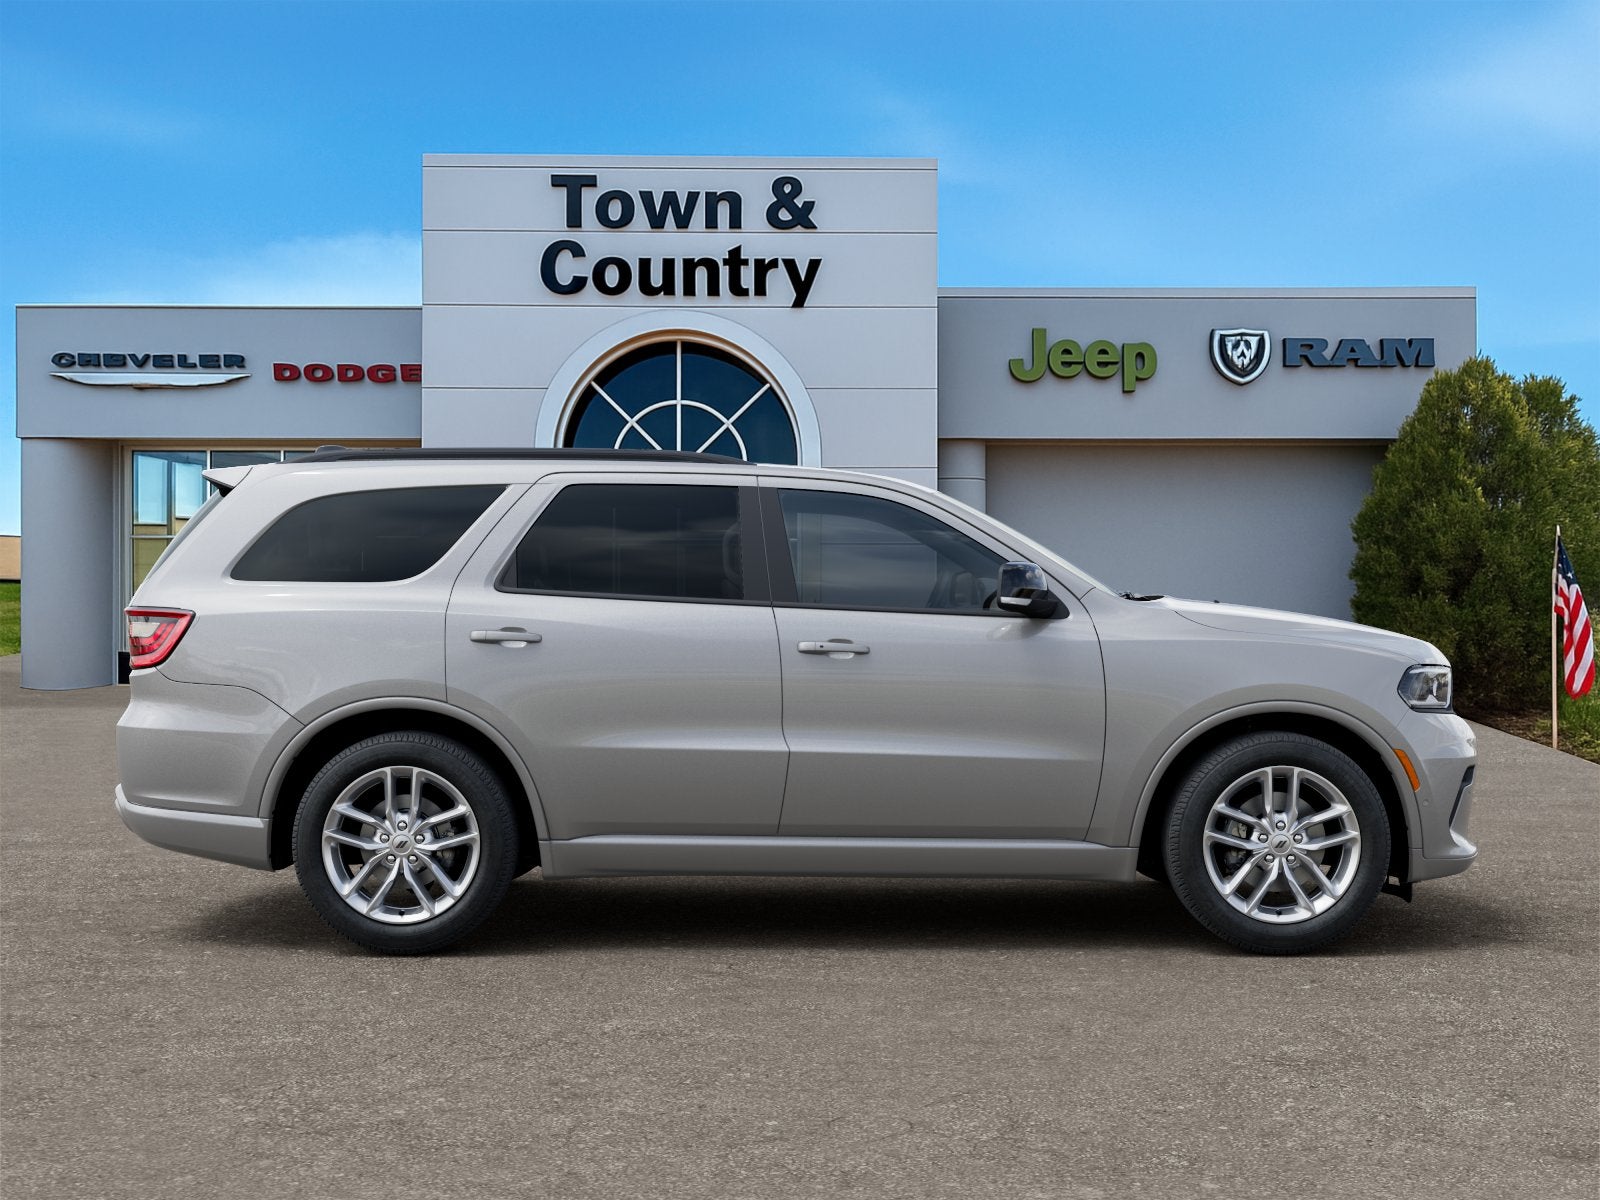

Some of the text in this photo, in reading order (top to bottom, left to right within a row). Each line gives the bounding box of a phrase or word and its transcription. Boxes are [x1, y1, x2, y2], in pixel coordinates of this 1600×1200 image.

[551, 174, 818, 229] Town &
[540, 240, 822, 308] Country
[273, 363, 422, 383] DODGE
[1009, 328, 1158, 393] Jeep
[1283, 338, 1435, 367] RAM
